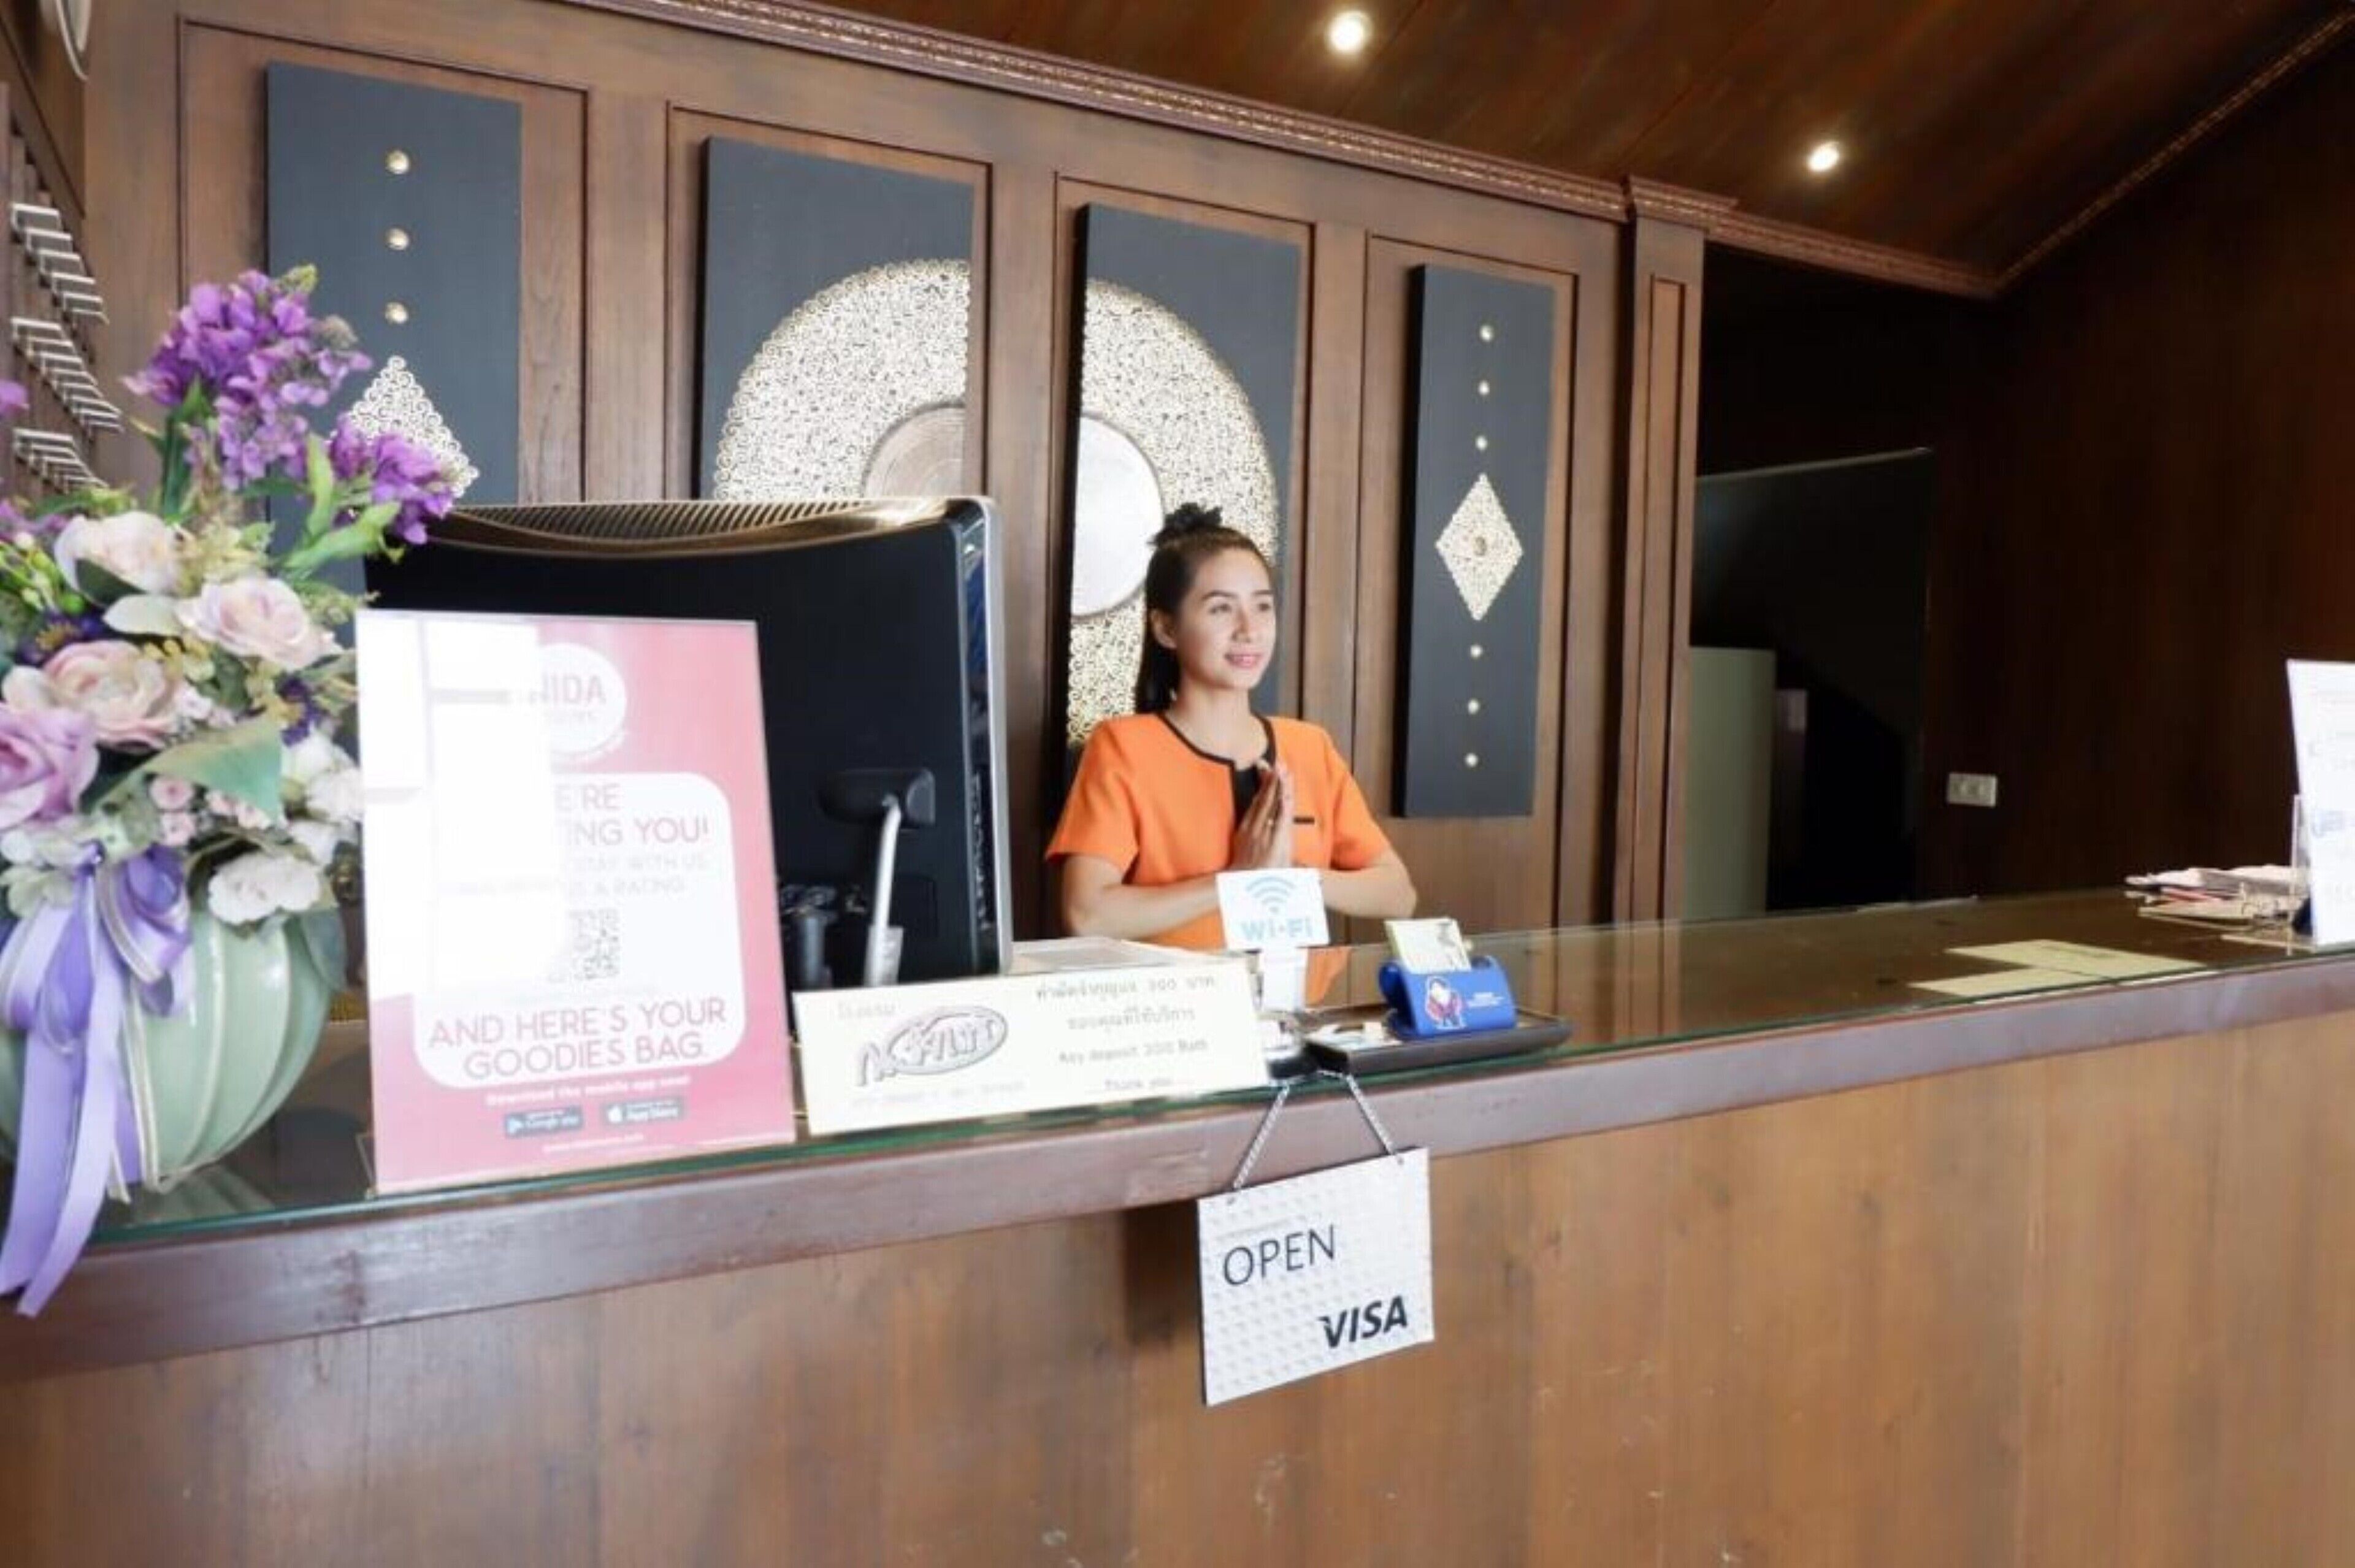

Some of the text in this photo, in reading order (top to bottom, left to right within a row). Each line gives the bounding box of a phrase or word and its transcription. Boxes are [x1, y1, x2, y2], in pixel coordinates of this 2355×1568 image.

[429, 1015, 504, 1049] AND
[638, 998, 727, 1030] YOUR
[463, 1042, 626, 1080] GOODIES
[1223, 1223, 1336, 1287] OPEN
[1317, 1294, 1409, 1349] VISA
